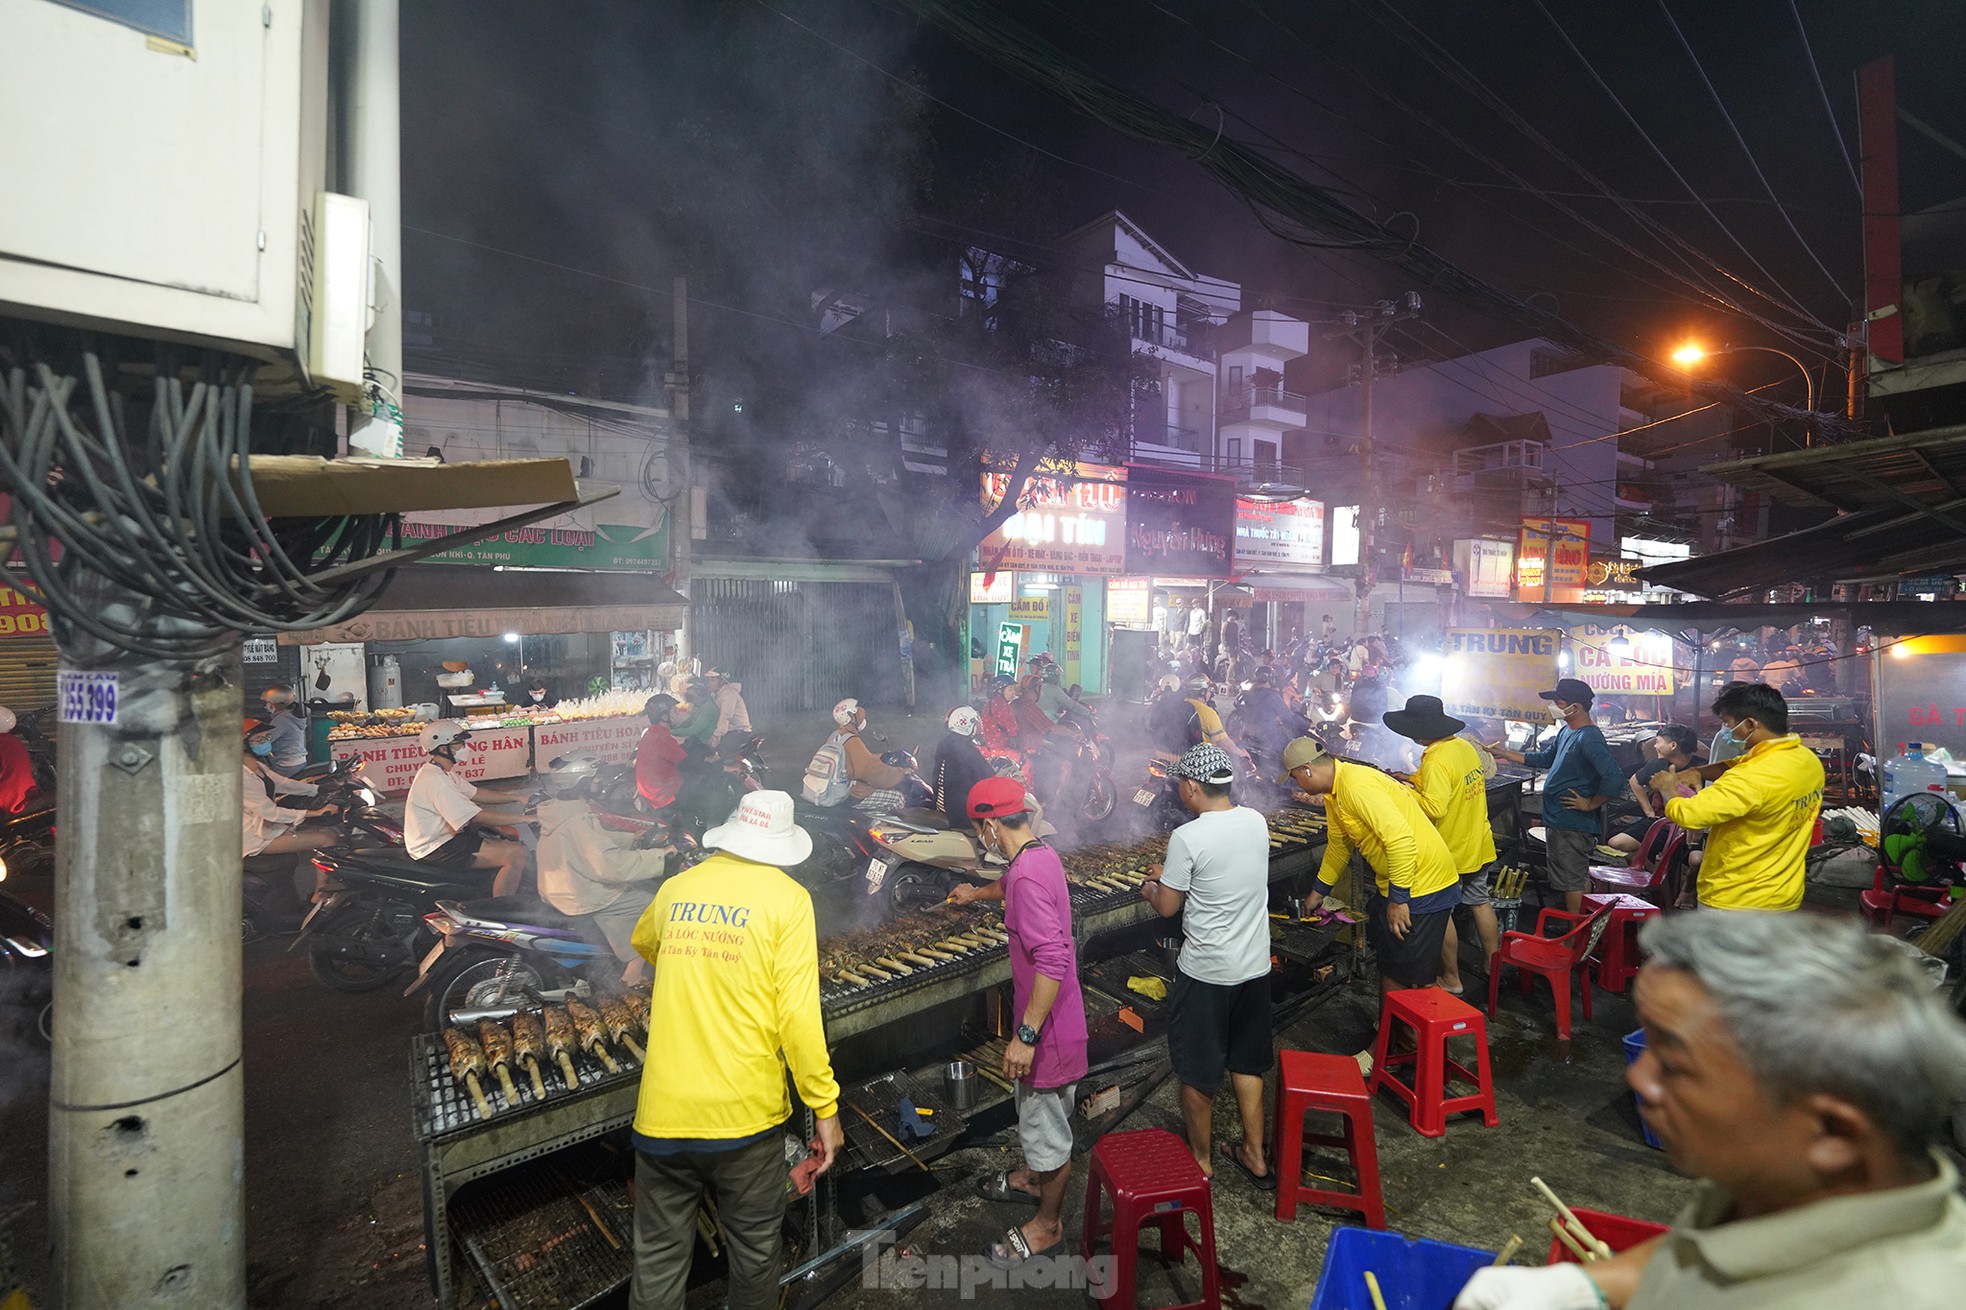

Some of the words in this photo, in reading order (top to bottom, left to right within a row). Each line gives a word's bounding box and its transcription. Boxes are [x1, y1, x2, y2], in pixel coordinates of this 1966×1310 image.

[1002, 645, 1014, 658] XE
[1450, 632, 1553, 656] TRUNG
[1579, 642, 1611, 667] CÁ
[1636, 672, 1667, 690] MÍA
[1909, 704, 1942, 726] GÀ
[492, 736, 524, 750] HÂN
[540, 728, 579, 745] BÁNH
[464, 768, 485, 778] 637
[669, 902, 751, 928] TRUNG
[675, 926, 699, 940] LÓC
[701, 930, 744, 946] NƯỚNG
